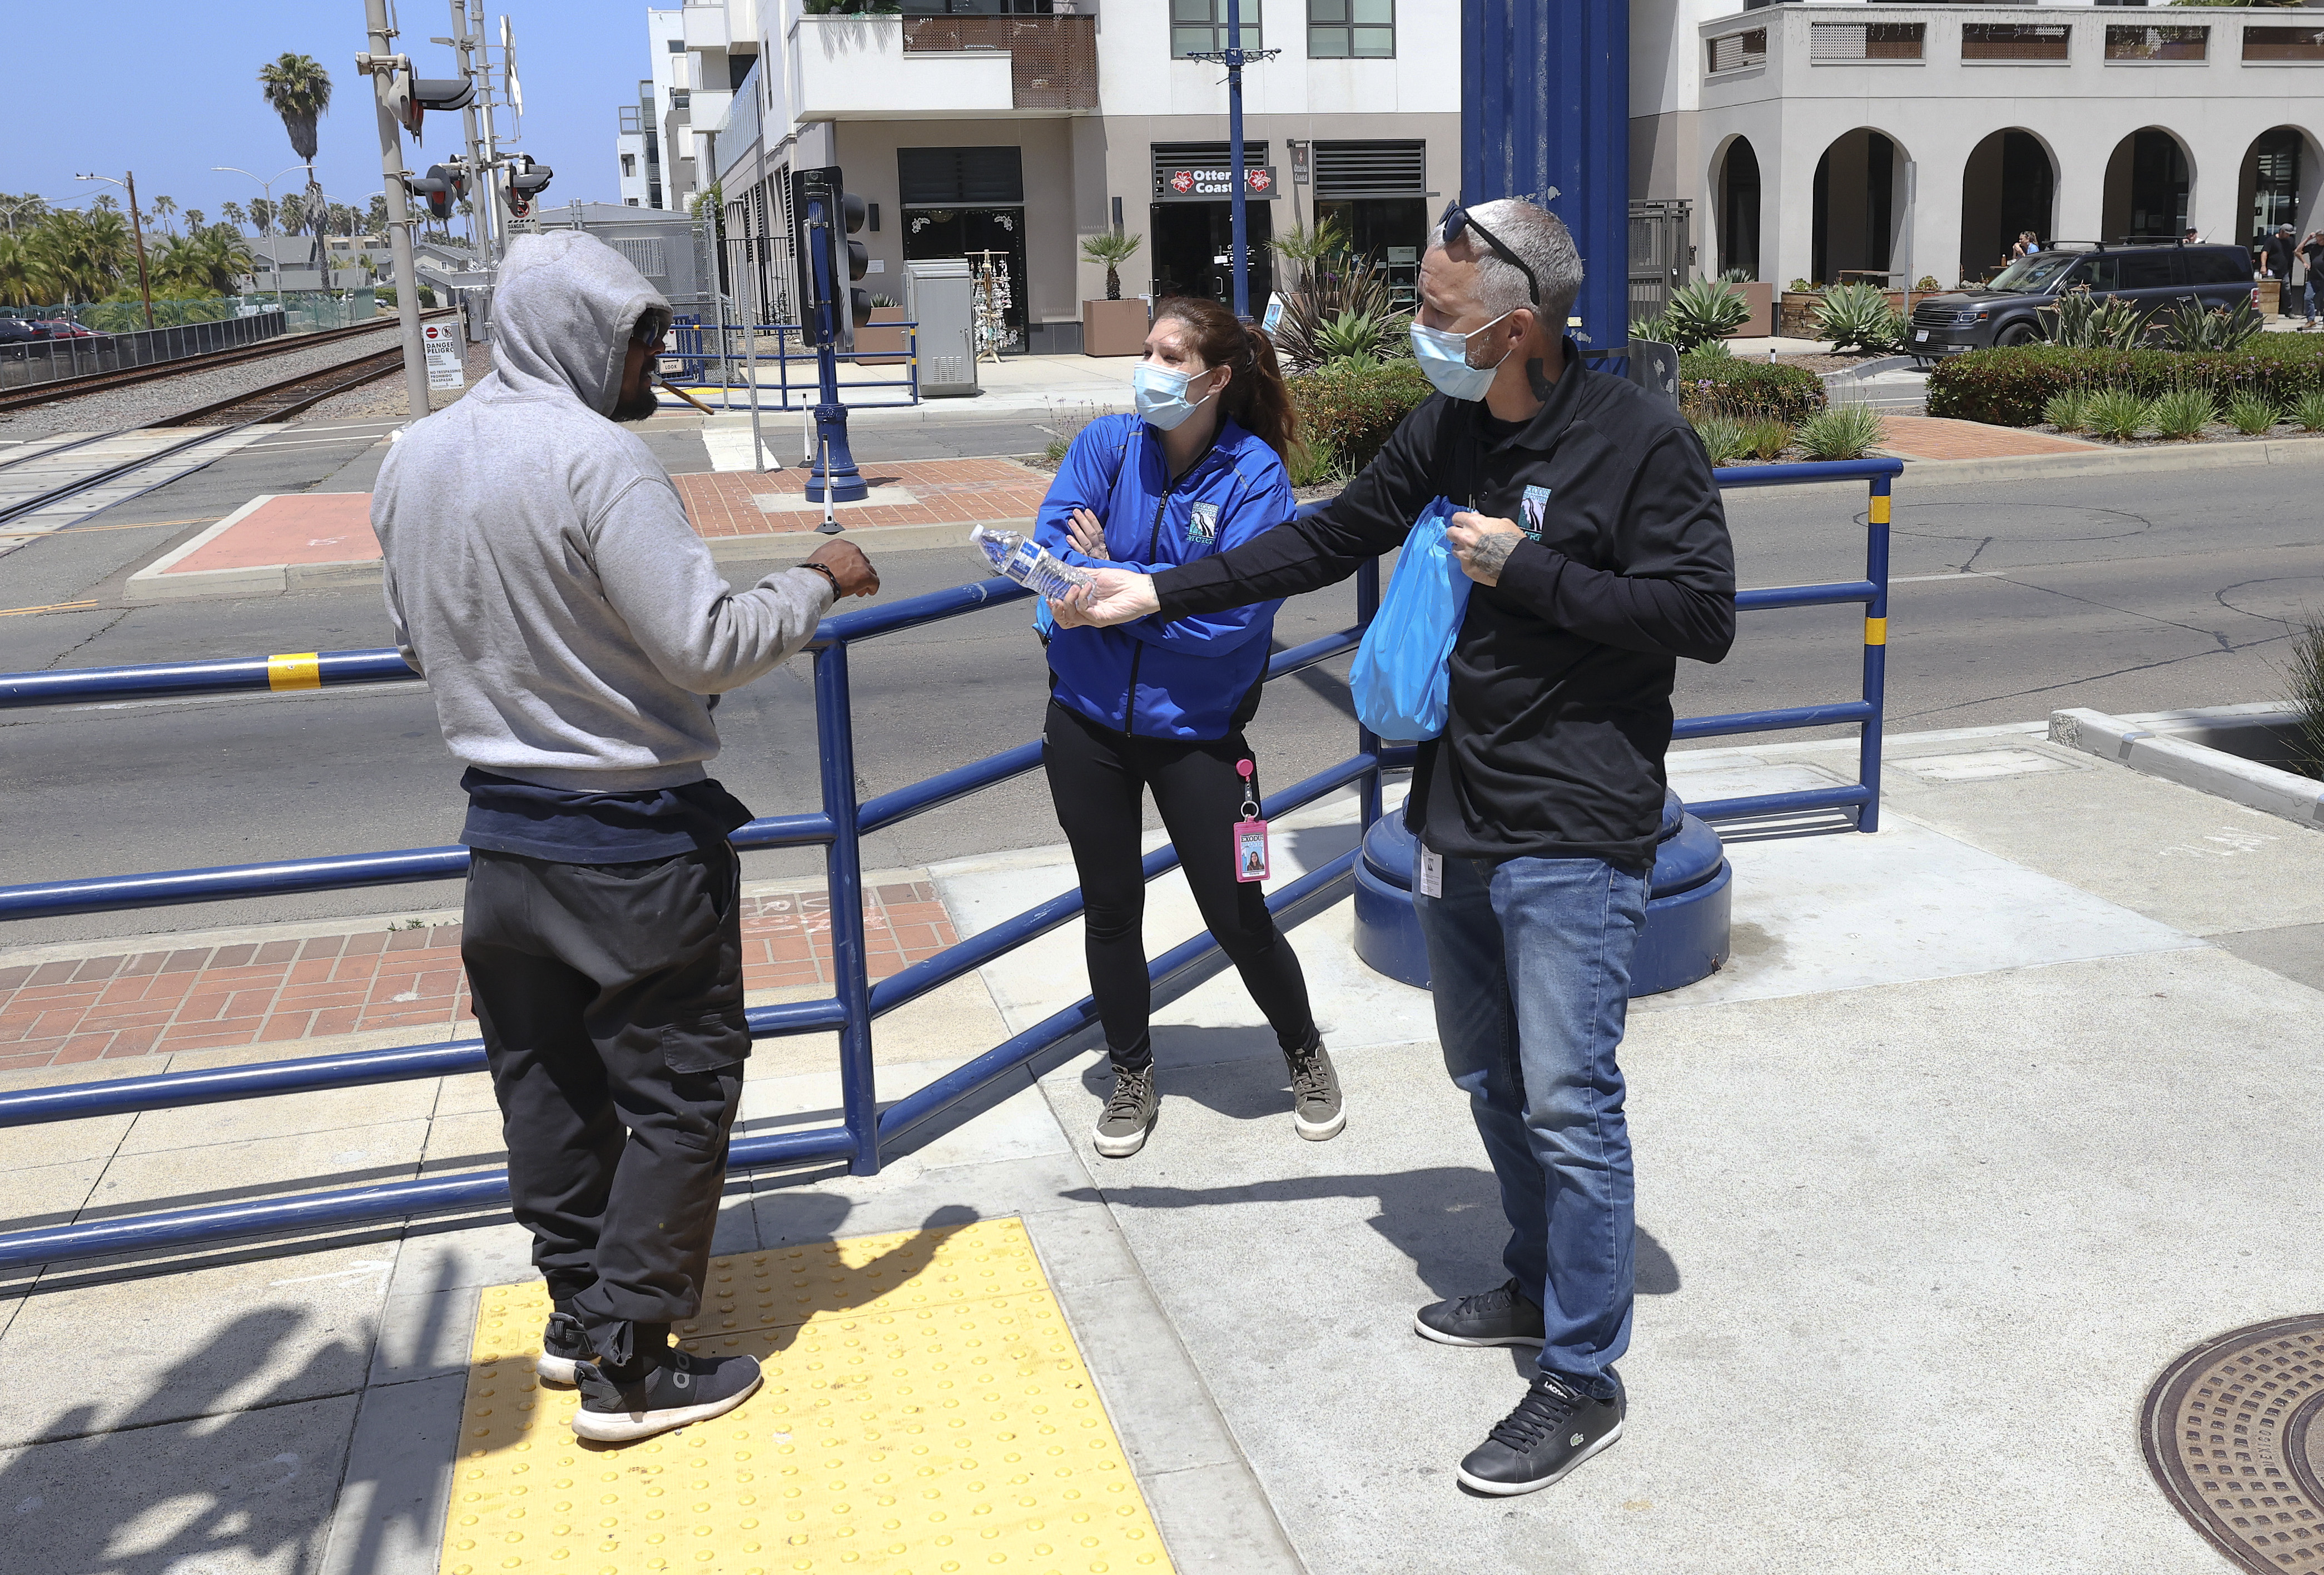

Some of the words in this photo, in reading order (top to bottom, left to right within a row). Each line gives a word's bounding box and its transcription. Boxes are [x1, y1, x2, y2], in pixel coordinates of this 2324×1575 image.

[1193, 169, 1248, 181] Otteri
[1294, 173, 1308, 182] Coastal
[1193, 502, 1219, 511] EXODUS
